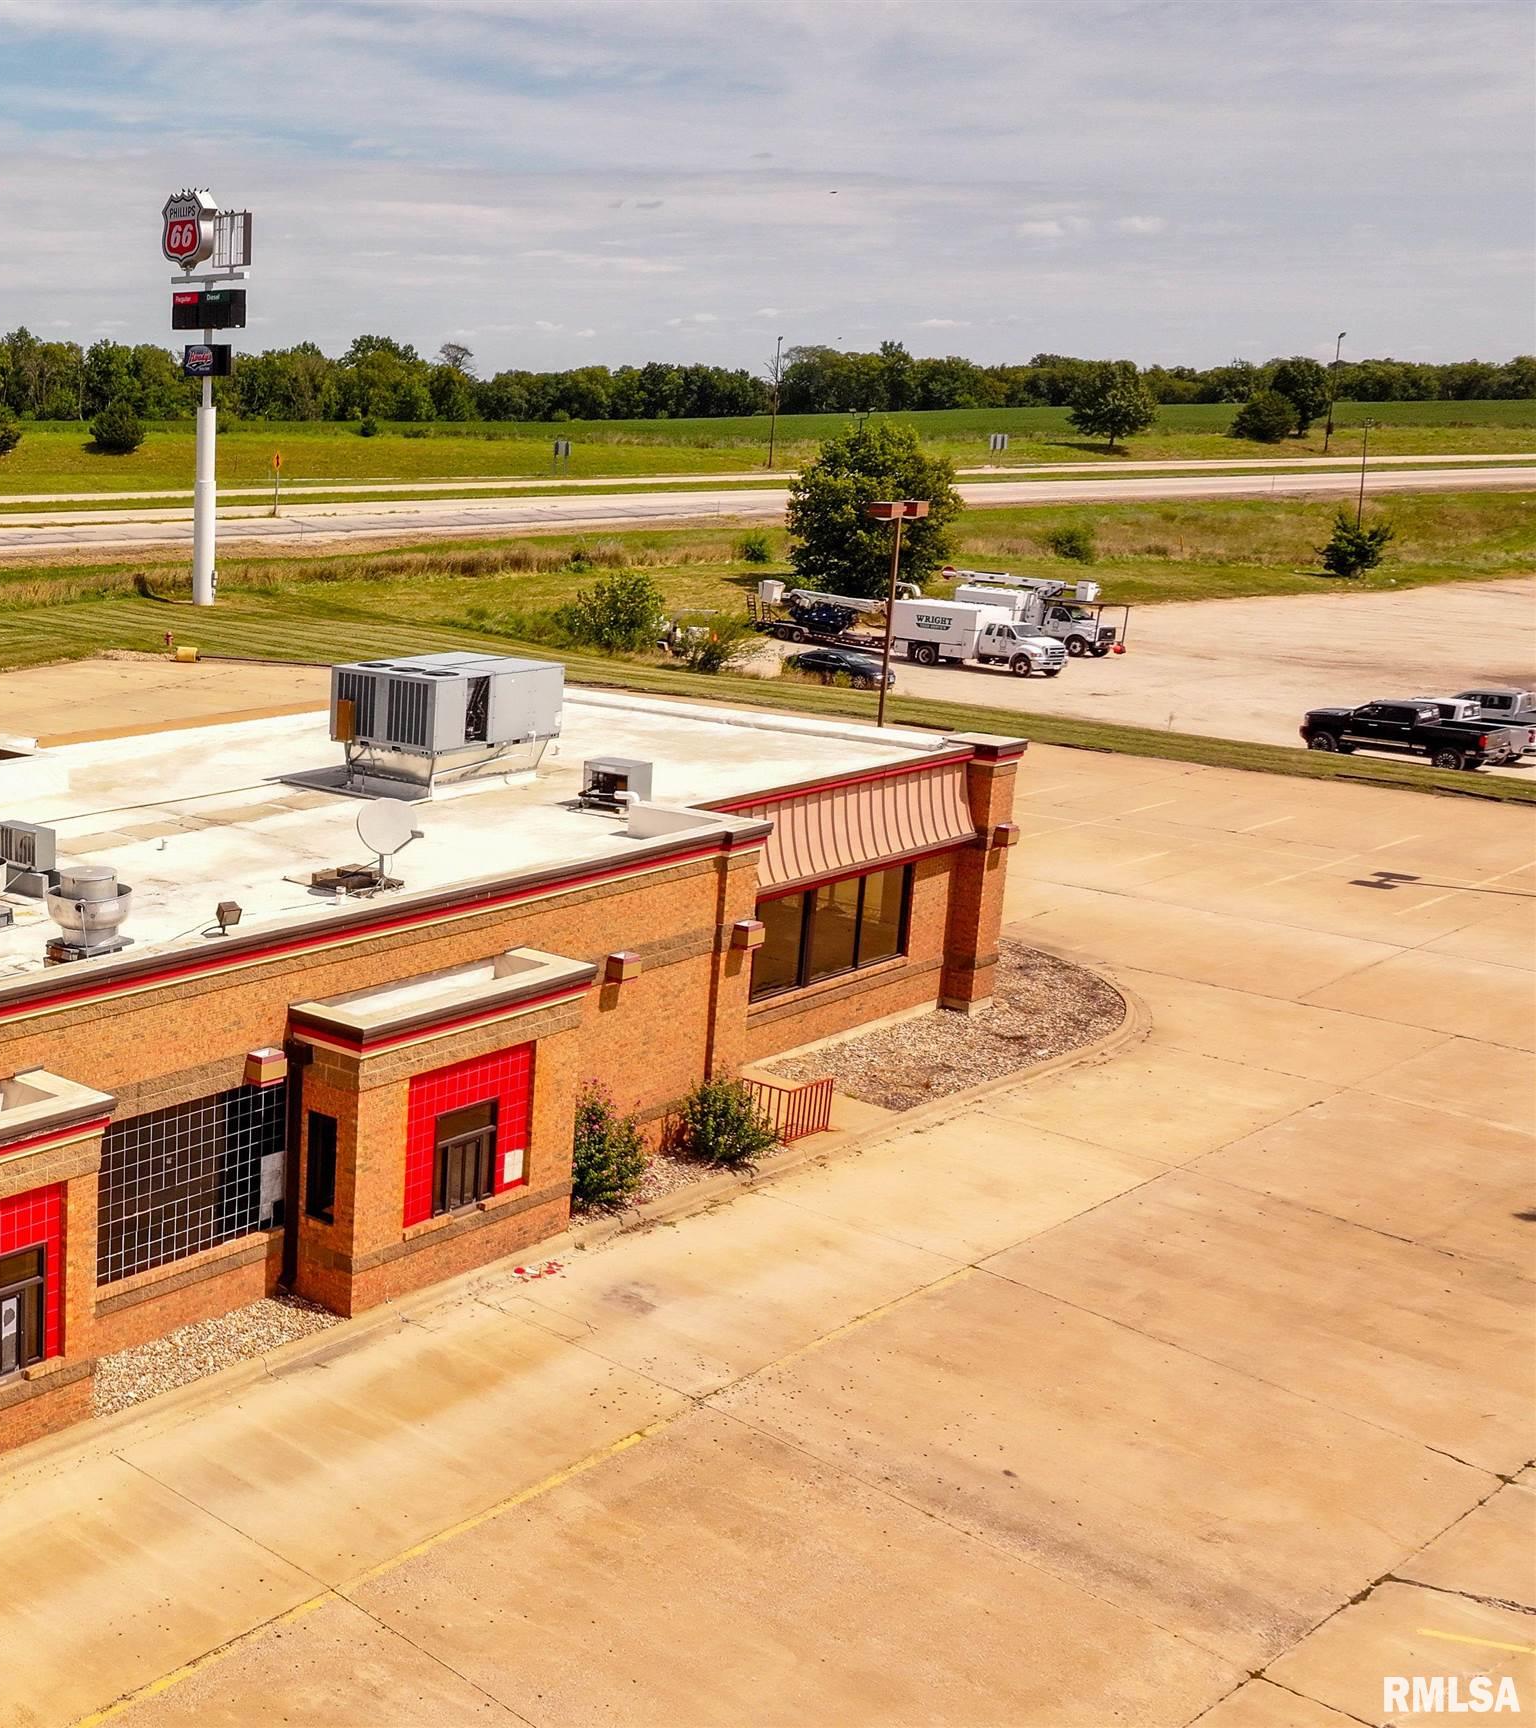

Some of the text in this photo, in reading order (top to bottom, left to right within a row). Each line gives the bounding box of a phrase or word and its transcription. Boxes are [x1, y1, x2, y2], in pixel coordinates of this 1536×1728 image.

[170, 205, 195, 219] PHILLIPS
[171, 224, 193, 248] 66
[916, 614, 953, 625] WRIGHT
